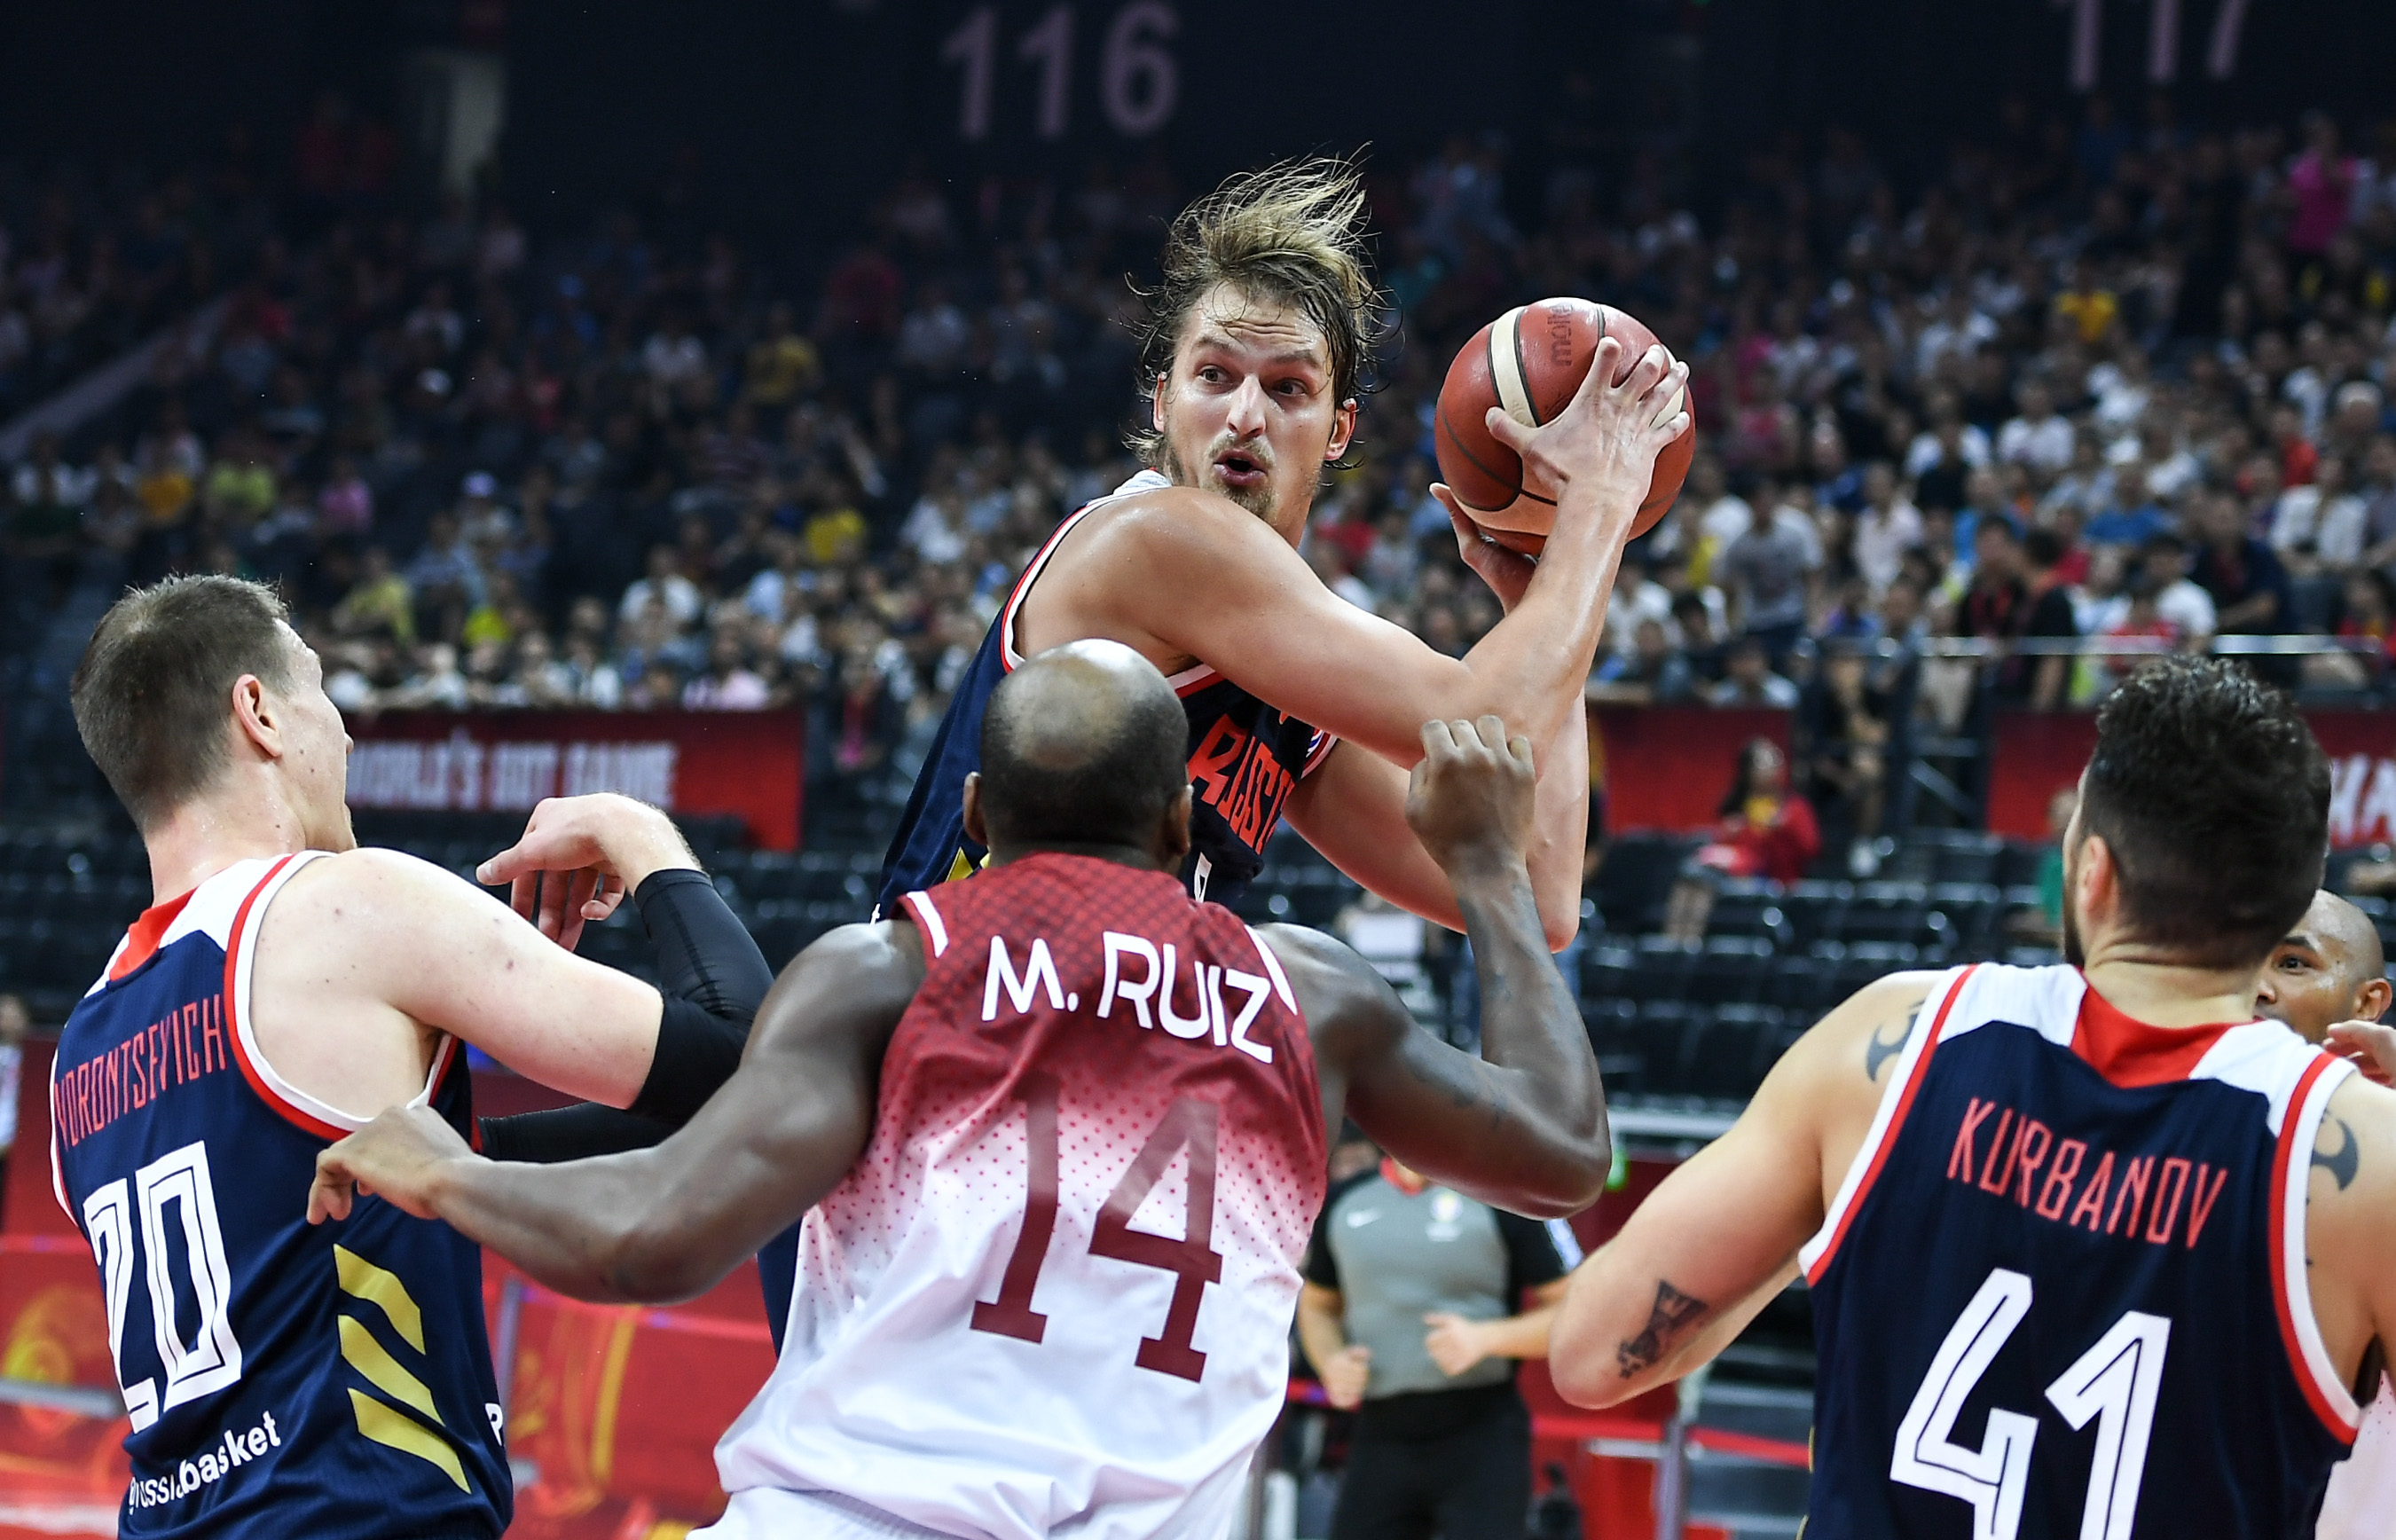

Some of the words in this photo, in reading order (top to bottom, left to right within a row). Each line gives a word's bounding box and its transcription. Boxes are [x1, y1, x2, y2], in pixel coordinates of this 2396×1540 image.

[943, 3, 1181, 138] 116
[54, 993, 227, 1152] VORONTSEVICH
[981, 935, 1080, 1022] M.
[1096, 931, 1273, 1065] RUIZ
[969, 1068, 1224, 1384] 14
[1946, 1096, 2229, 1250] KURBANOV
[82, 1140, 242, 1434] 20
[1889, 1267, 2172, 1540] 41
